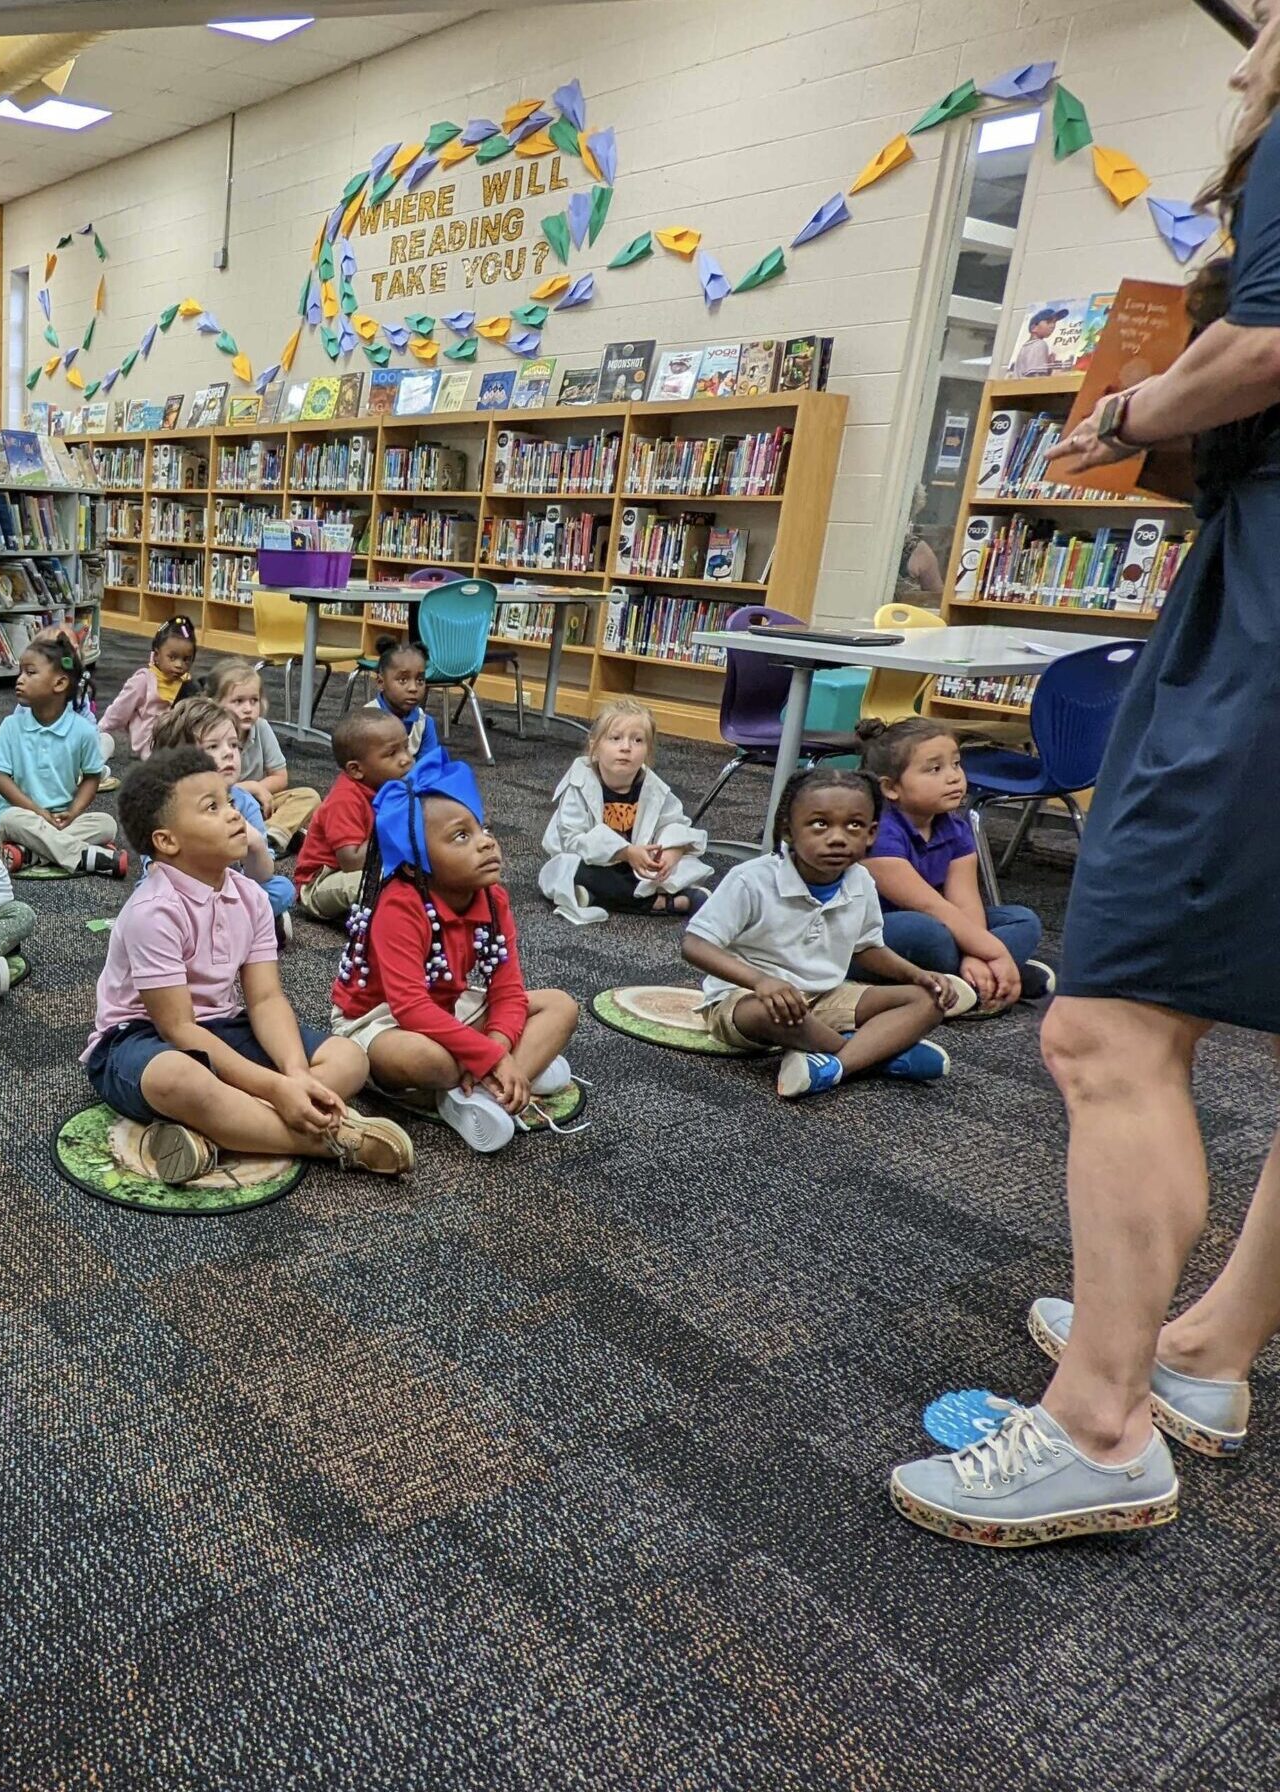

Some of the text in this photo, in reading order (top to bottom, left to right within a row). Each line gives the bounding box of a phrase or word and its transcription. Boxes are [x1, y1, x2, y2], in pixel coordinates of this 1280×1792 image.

[358, 156, 569, 236] WHERE WILL
[389, 207, 525, 265] READING
[371, 240, 551, 302] TAKE YOU?
[1059, 328, 1083, 336] THEM
[1053, 336, 1081, 346] PLAY
[707, 347, 738, 360] yoga
[607, 357, 645, 369] MOONSHOT
[991, 420, 1010, 430] 780
[1136, 530, 1157, 541] 796
